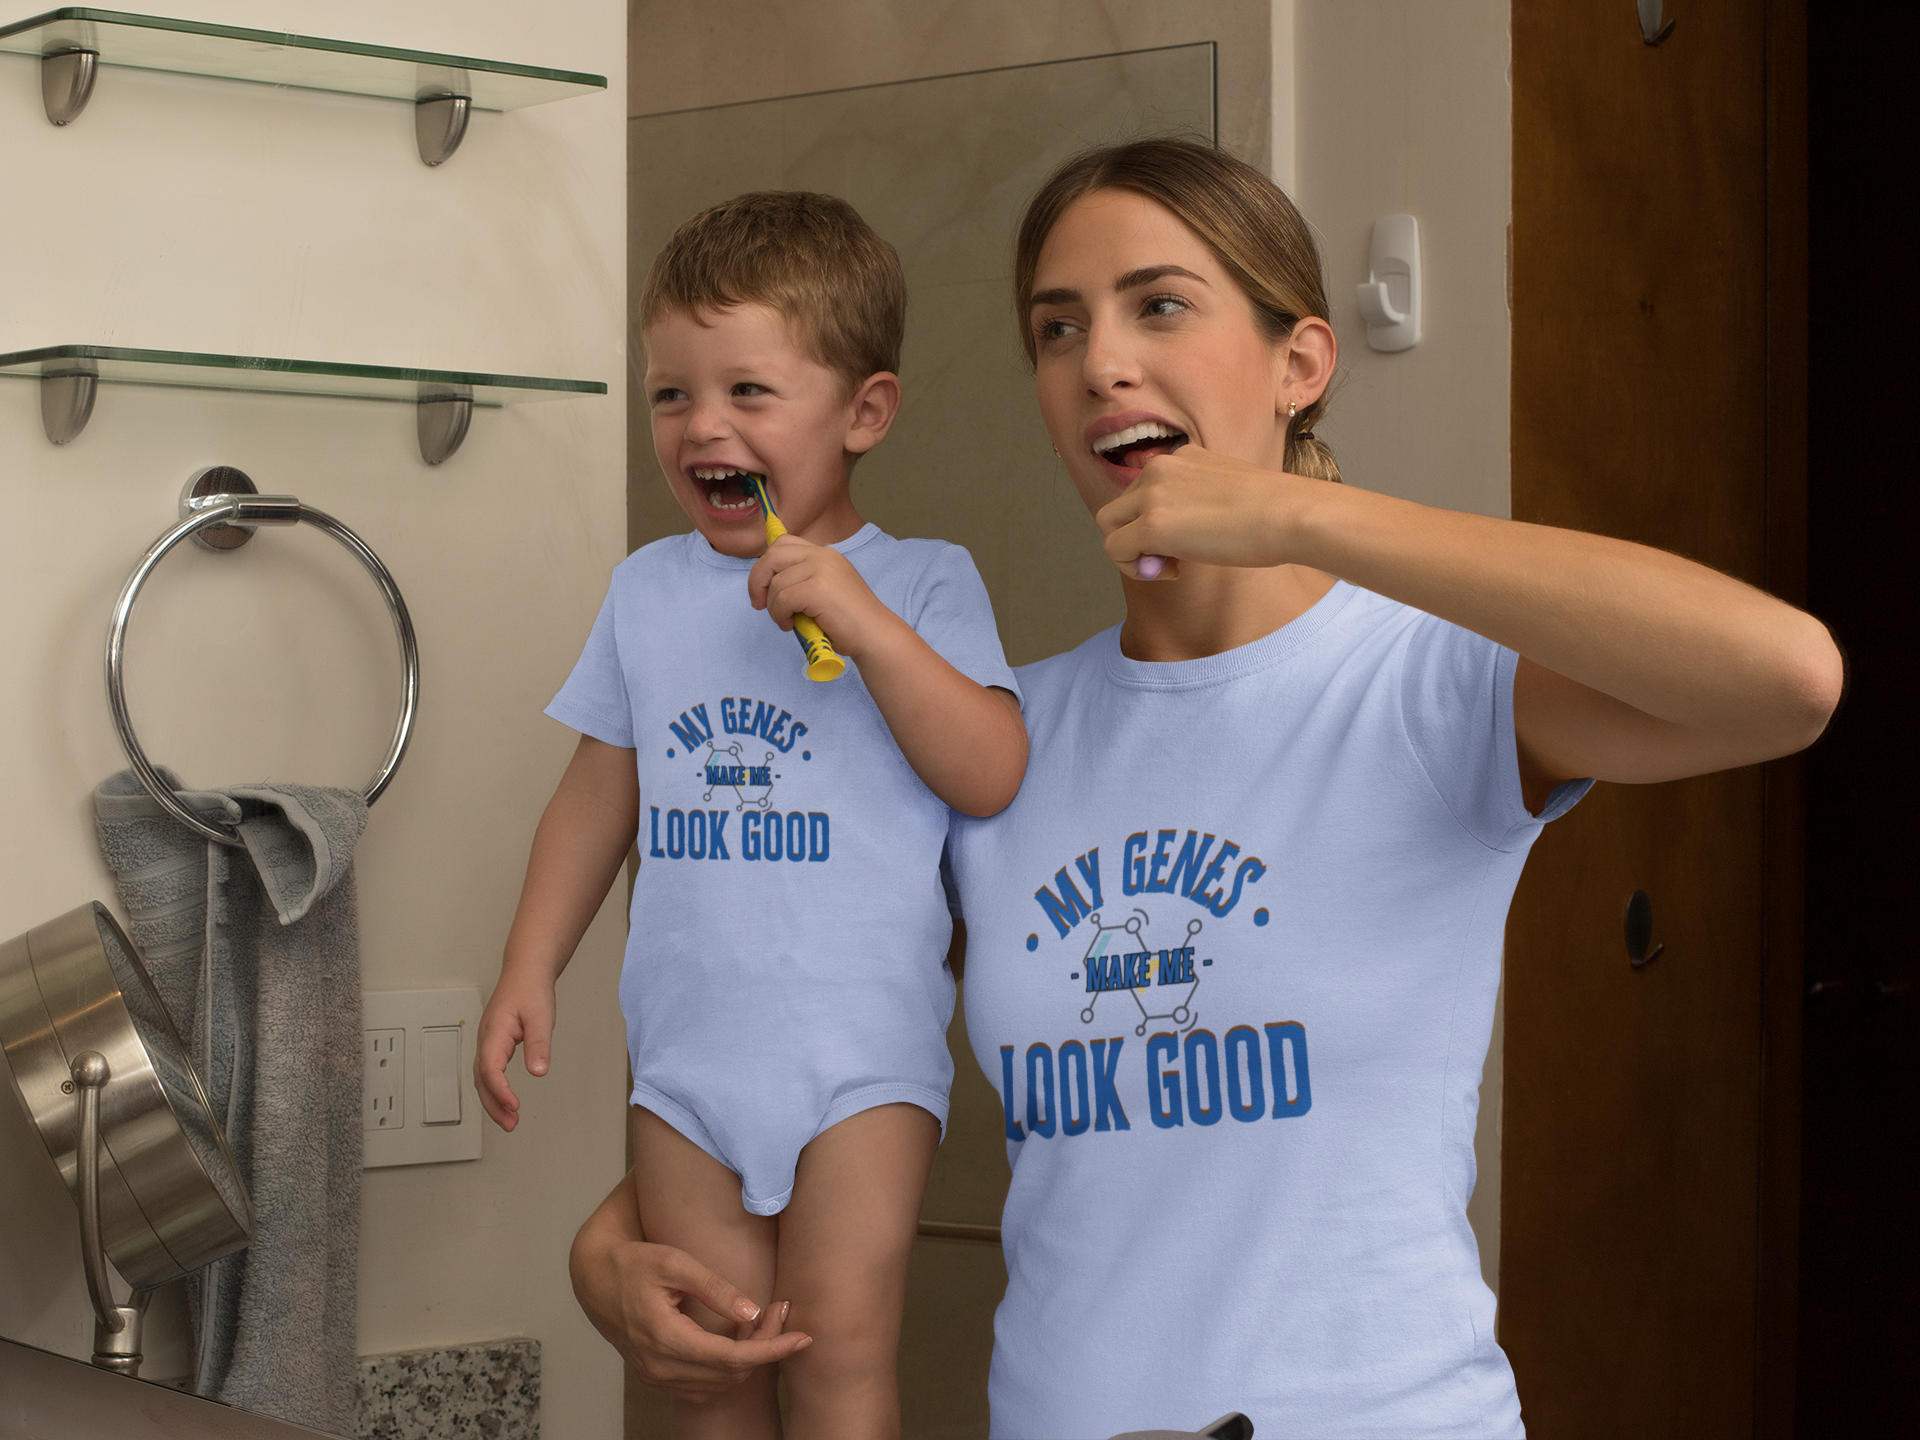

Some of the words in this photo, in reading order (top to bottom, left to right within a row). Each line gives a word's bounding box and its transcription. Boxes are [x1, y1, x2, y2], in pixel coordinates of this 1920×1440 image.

[669, 703, 714, 754] MY
[721, 697, 808, 754] GENES
[706, 765, 745, 785] MAKE
[749, 766, 771, 786] ME
[650, 805, 730, 860] LOOK
[742, 810, 830, 862] GOOD
[1034, 847, 1104, 940] MY
[1122, 829, 1267, 918] GENES
[1086, 951, 1151, 992] MAKE
[1157, 947, 1195, 985] ME
[1000, 1036, 1131, 1142] LOOK
[1146, 1020, 1312, 1129] GOOD
